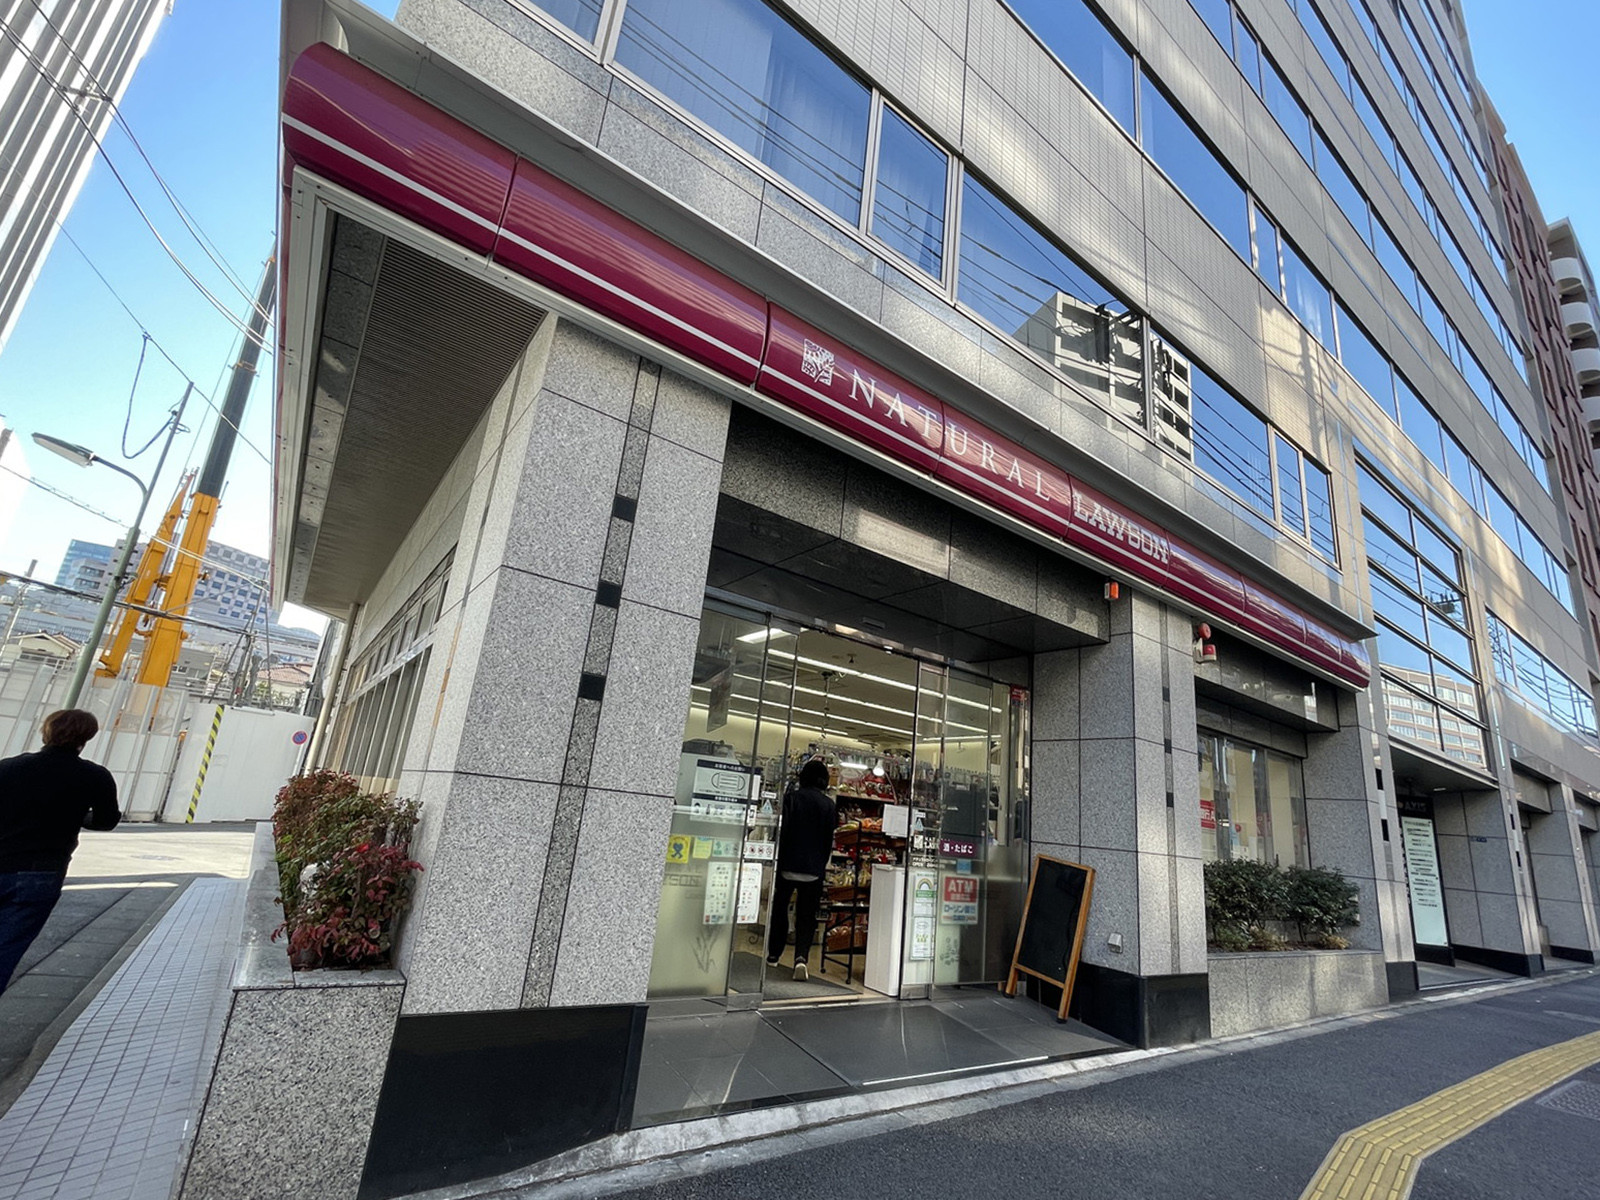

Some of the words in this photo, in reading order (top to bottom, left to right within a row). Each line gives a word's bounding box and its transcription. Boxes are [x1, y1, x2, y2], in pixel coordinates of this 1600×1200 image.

[848, 368, 1051, 501] NATURAL
[1072, 490, 1169, 565] LAWSON
[948, 880, 974, 893] ATM
